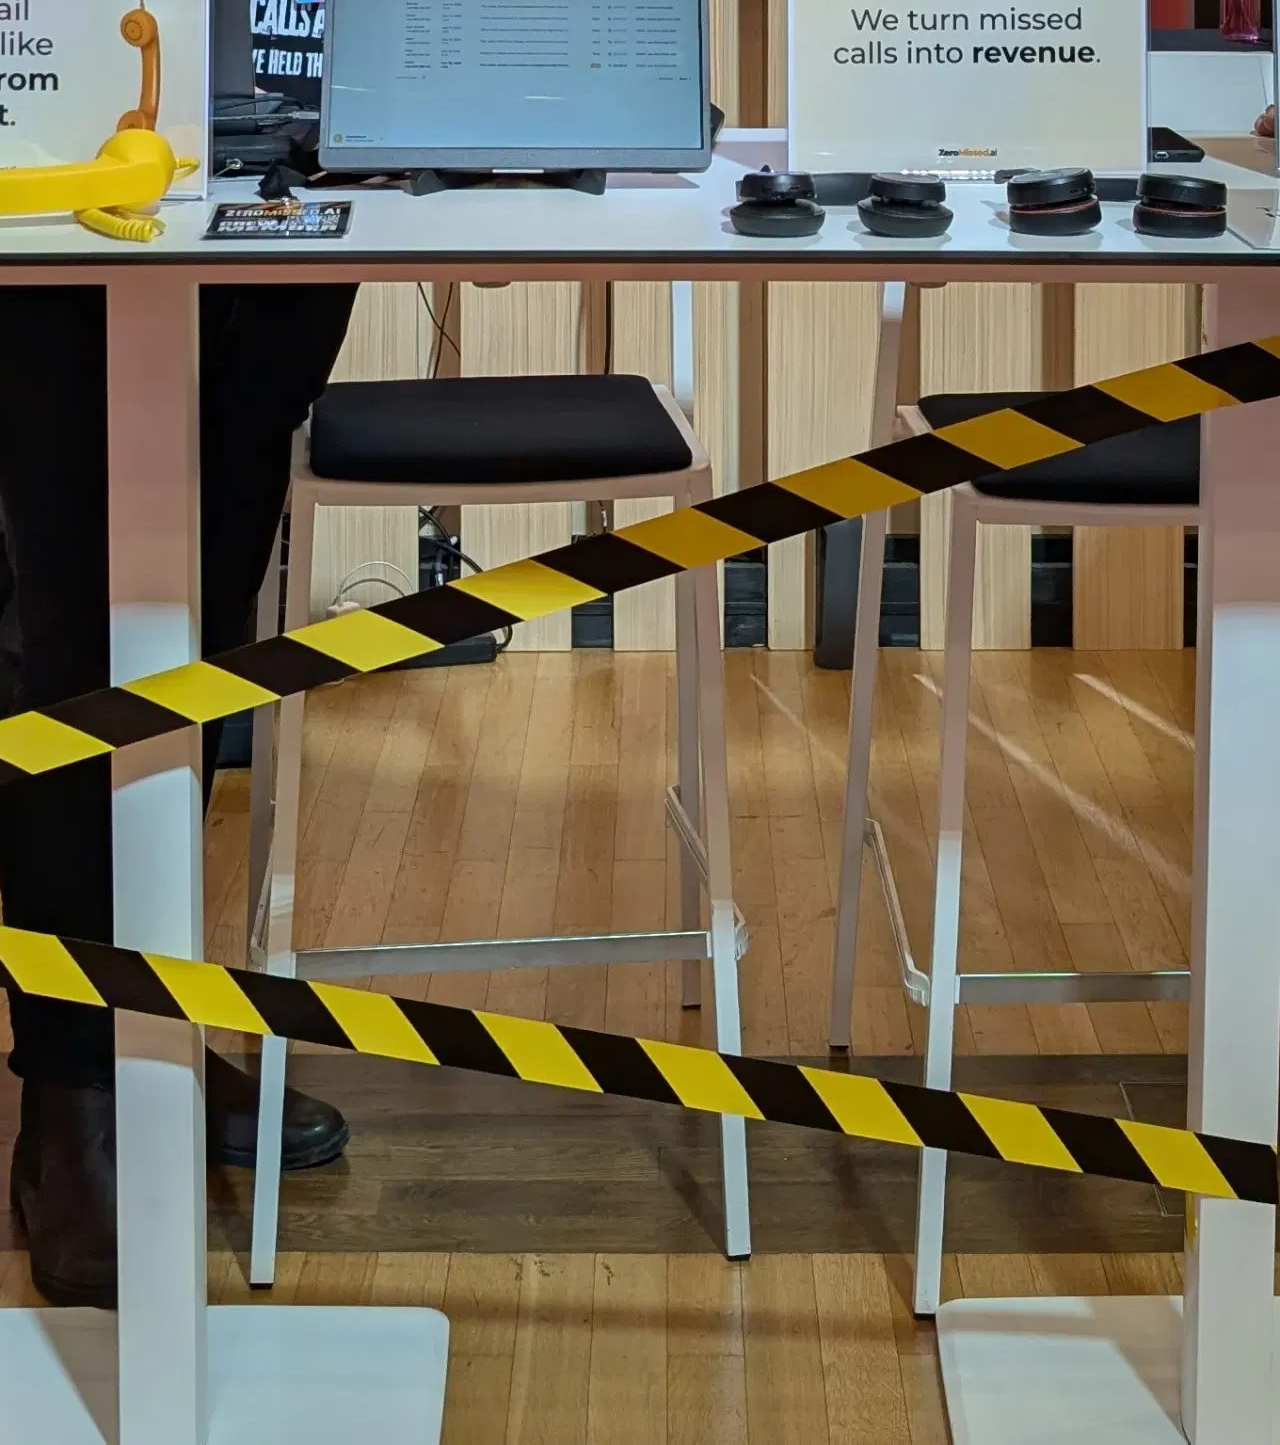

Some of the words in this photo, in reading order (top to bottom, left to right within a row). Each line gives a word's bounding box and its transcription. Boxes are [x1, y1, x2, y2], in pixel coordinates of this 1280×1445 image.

[851, 9, 899, 31] We
[907, 10, 969, 31] turn
[980, 7, 1082, 31] missed
[1, 31, 54, 56] like
[833, 41, 898, 65] calls
[907, 41, 963, 64] into
[973, 45, 1101, 64] revenue.
[268, 49, 303, 76] HELD
[305, 52, 324, 78] TH
[938, 148, 997, 156] ZeroMissed.ai
